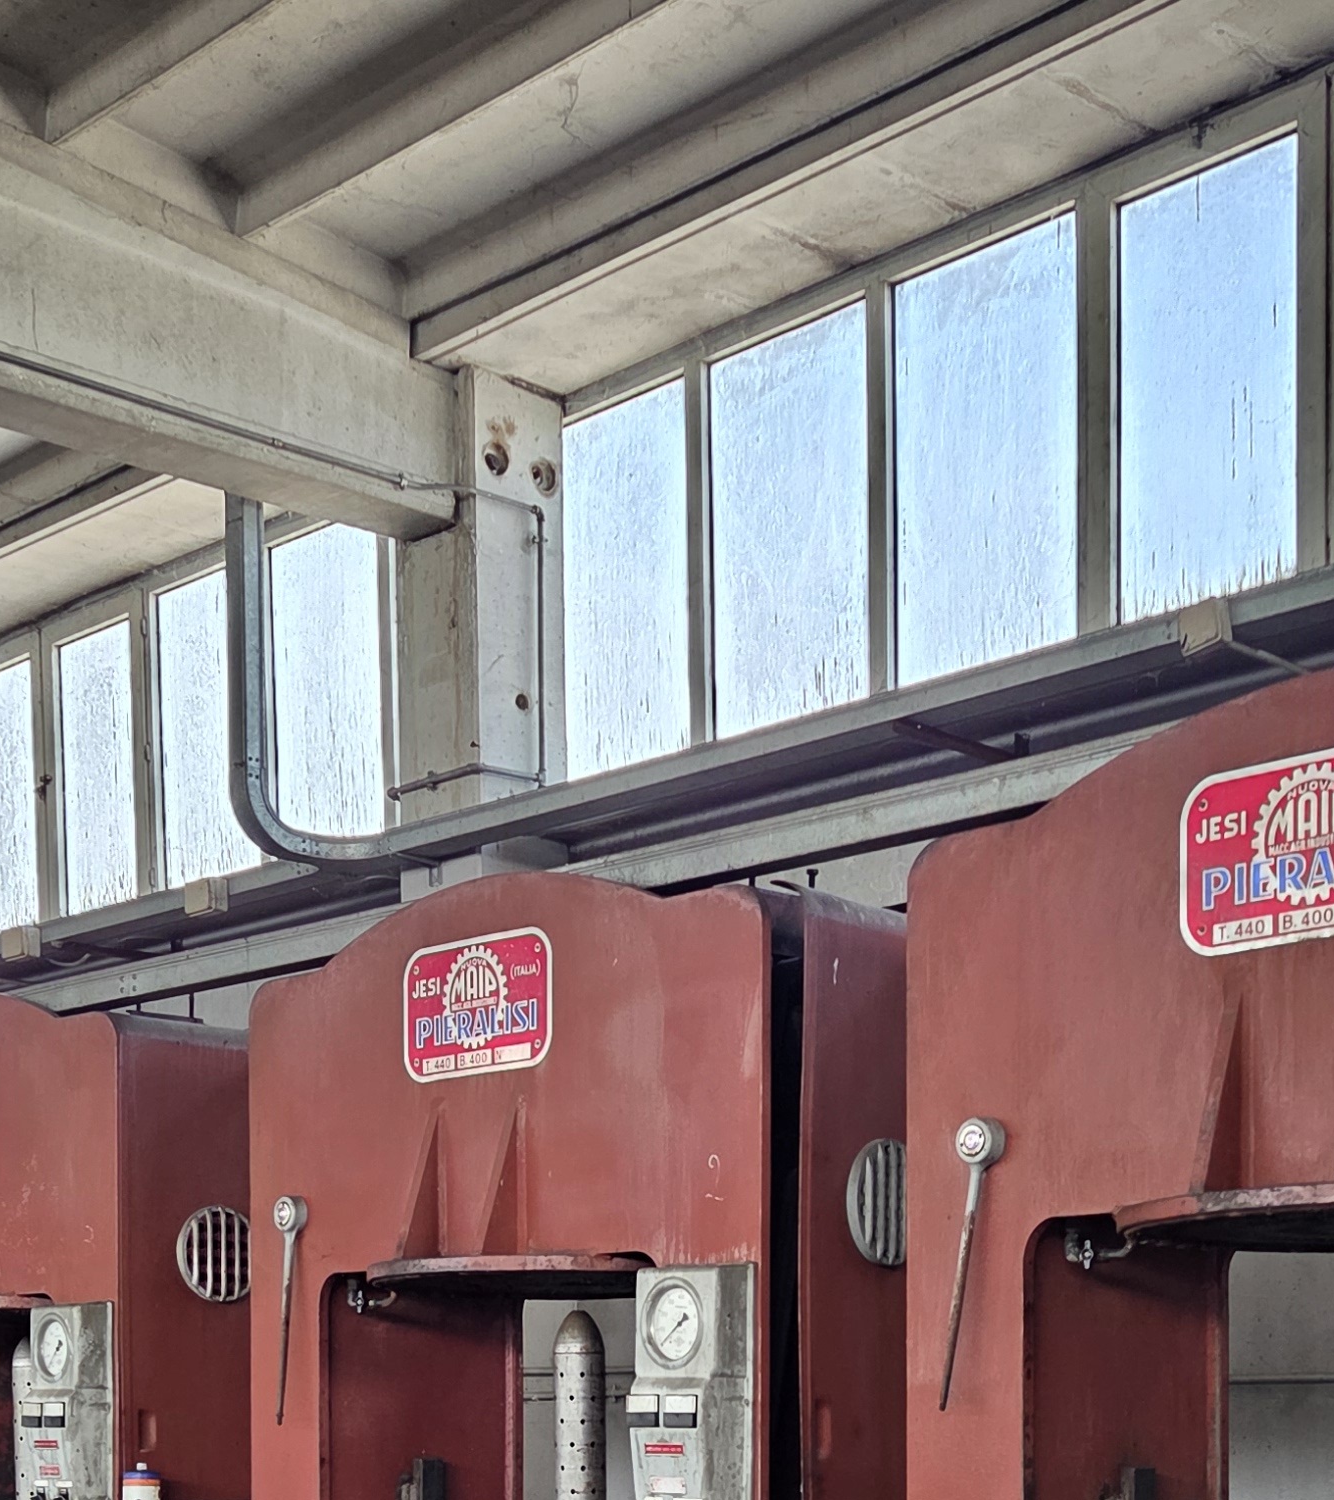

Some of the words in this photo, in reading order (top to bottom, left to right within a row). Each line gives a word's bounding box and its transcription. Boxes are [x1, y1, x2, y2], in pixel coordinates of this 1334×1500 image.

[1195, 810, 1247, 844] JESI
[412, 977, 440, 999] JESI
[451, 965, 497, 1003] MAIP
[416, 998, 537, 1049] PIERALISI
